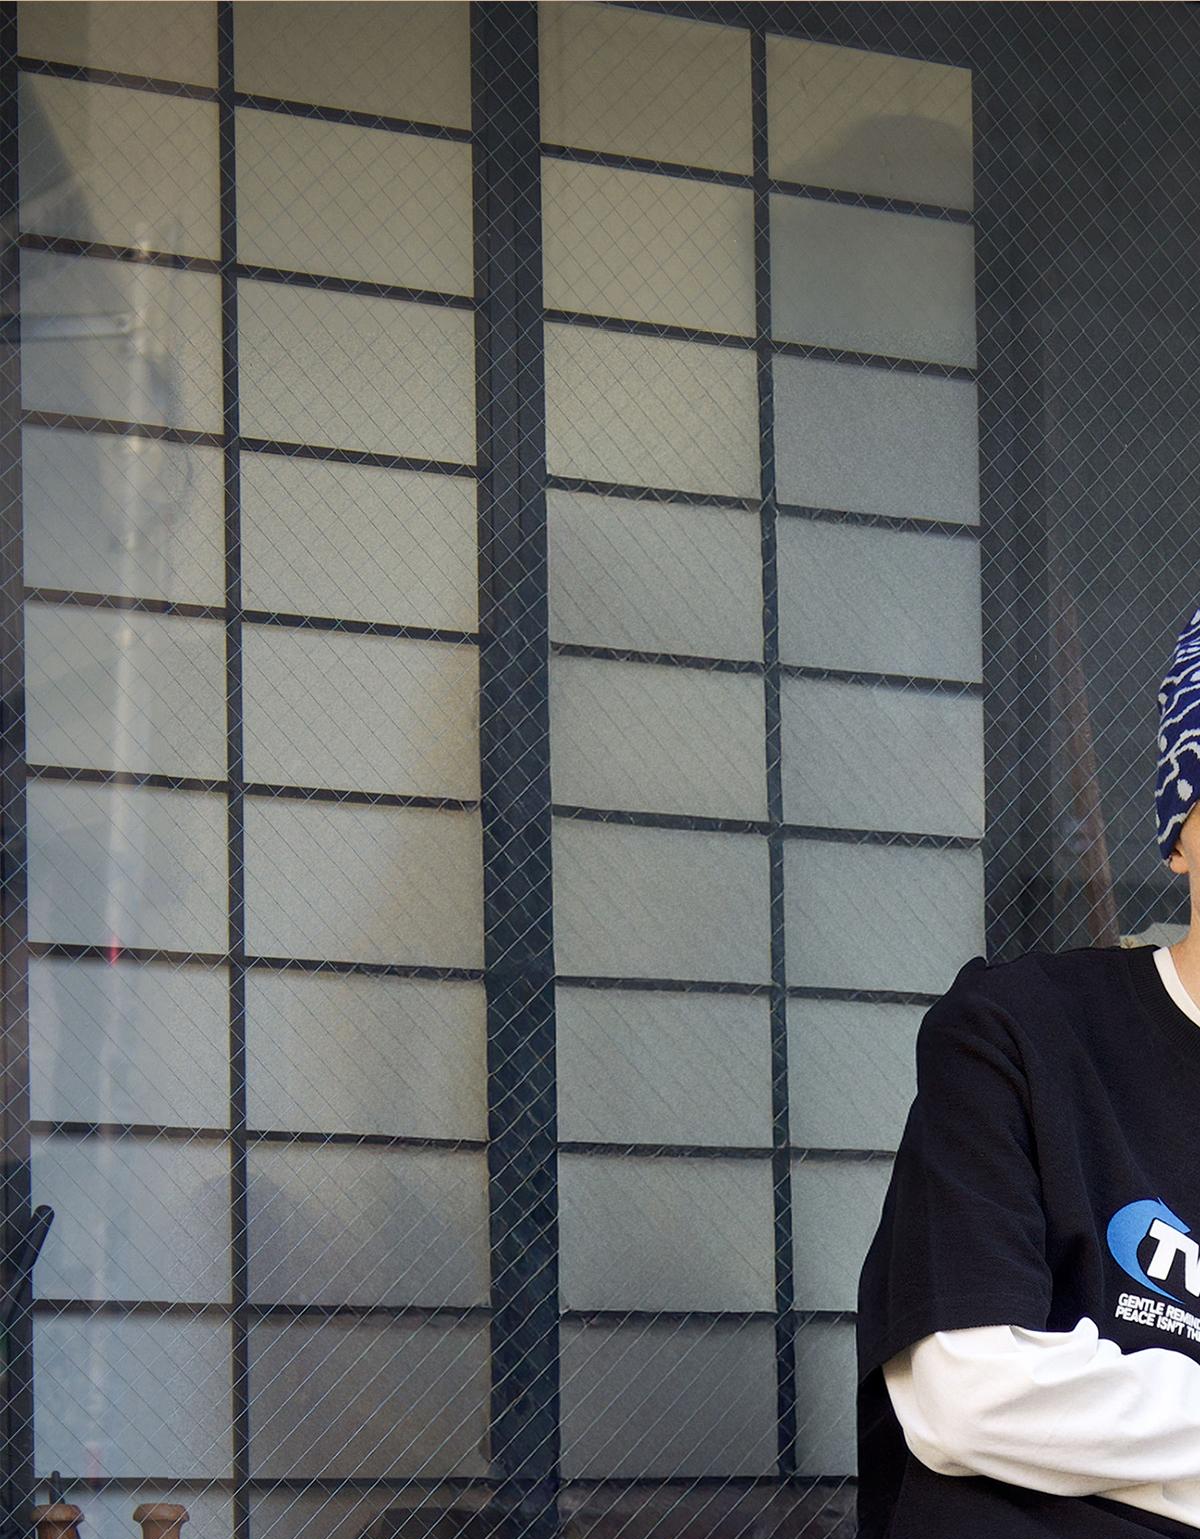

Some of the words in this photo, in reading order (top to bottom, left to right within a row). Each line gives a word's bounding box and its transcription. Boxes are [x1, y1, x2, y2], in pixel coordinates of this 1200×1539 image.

[1117, 1292, 1166, 1316] GENTLE
[1115, 1306, 1155, 1327] PEACE
[1156, 1318, 1185, 1336] ISN'T
